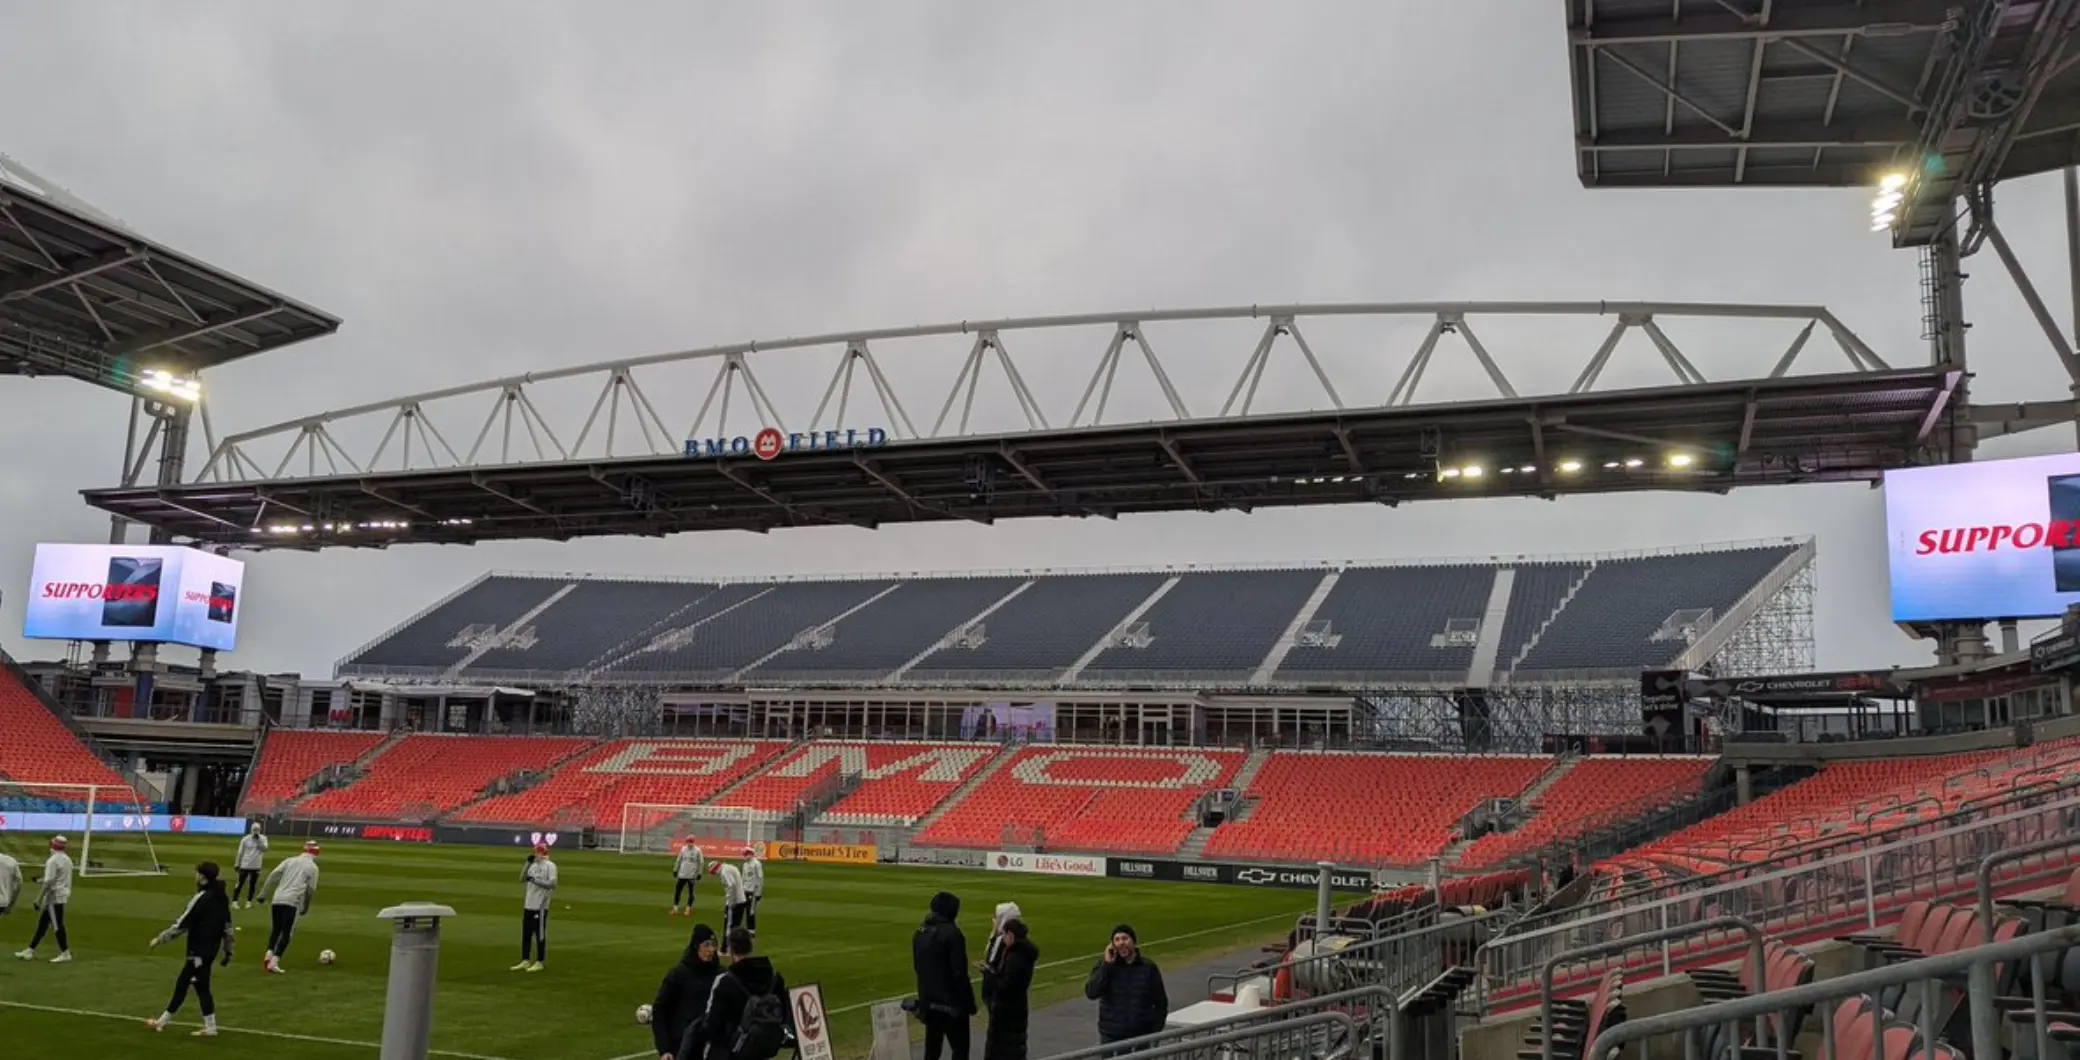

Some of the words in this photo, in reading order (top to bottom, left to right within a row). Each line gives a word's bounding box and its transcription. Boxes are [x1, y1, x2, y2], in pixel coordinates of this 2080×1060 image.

[685, 436, 750, 456] BMO
[789, 428, 887, 449] FIELD
[1916, 519, 2080, 555] SUPPOR
[1766, 679, 1832, 690] CHEVROLET
[582, 741, 1222, 790] BMO
[1010, 857, 1024, 867] LG
[1280, 872, 1368, 887] CHEVOLET
